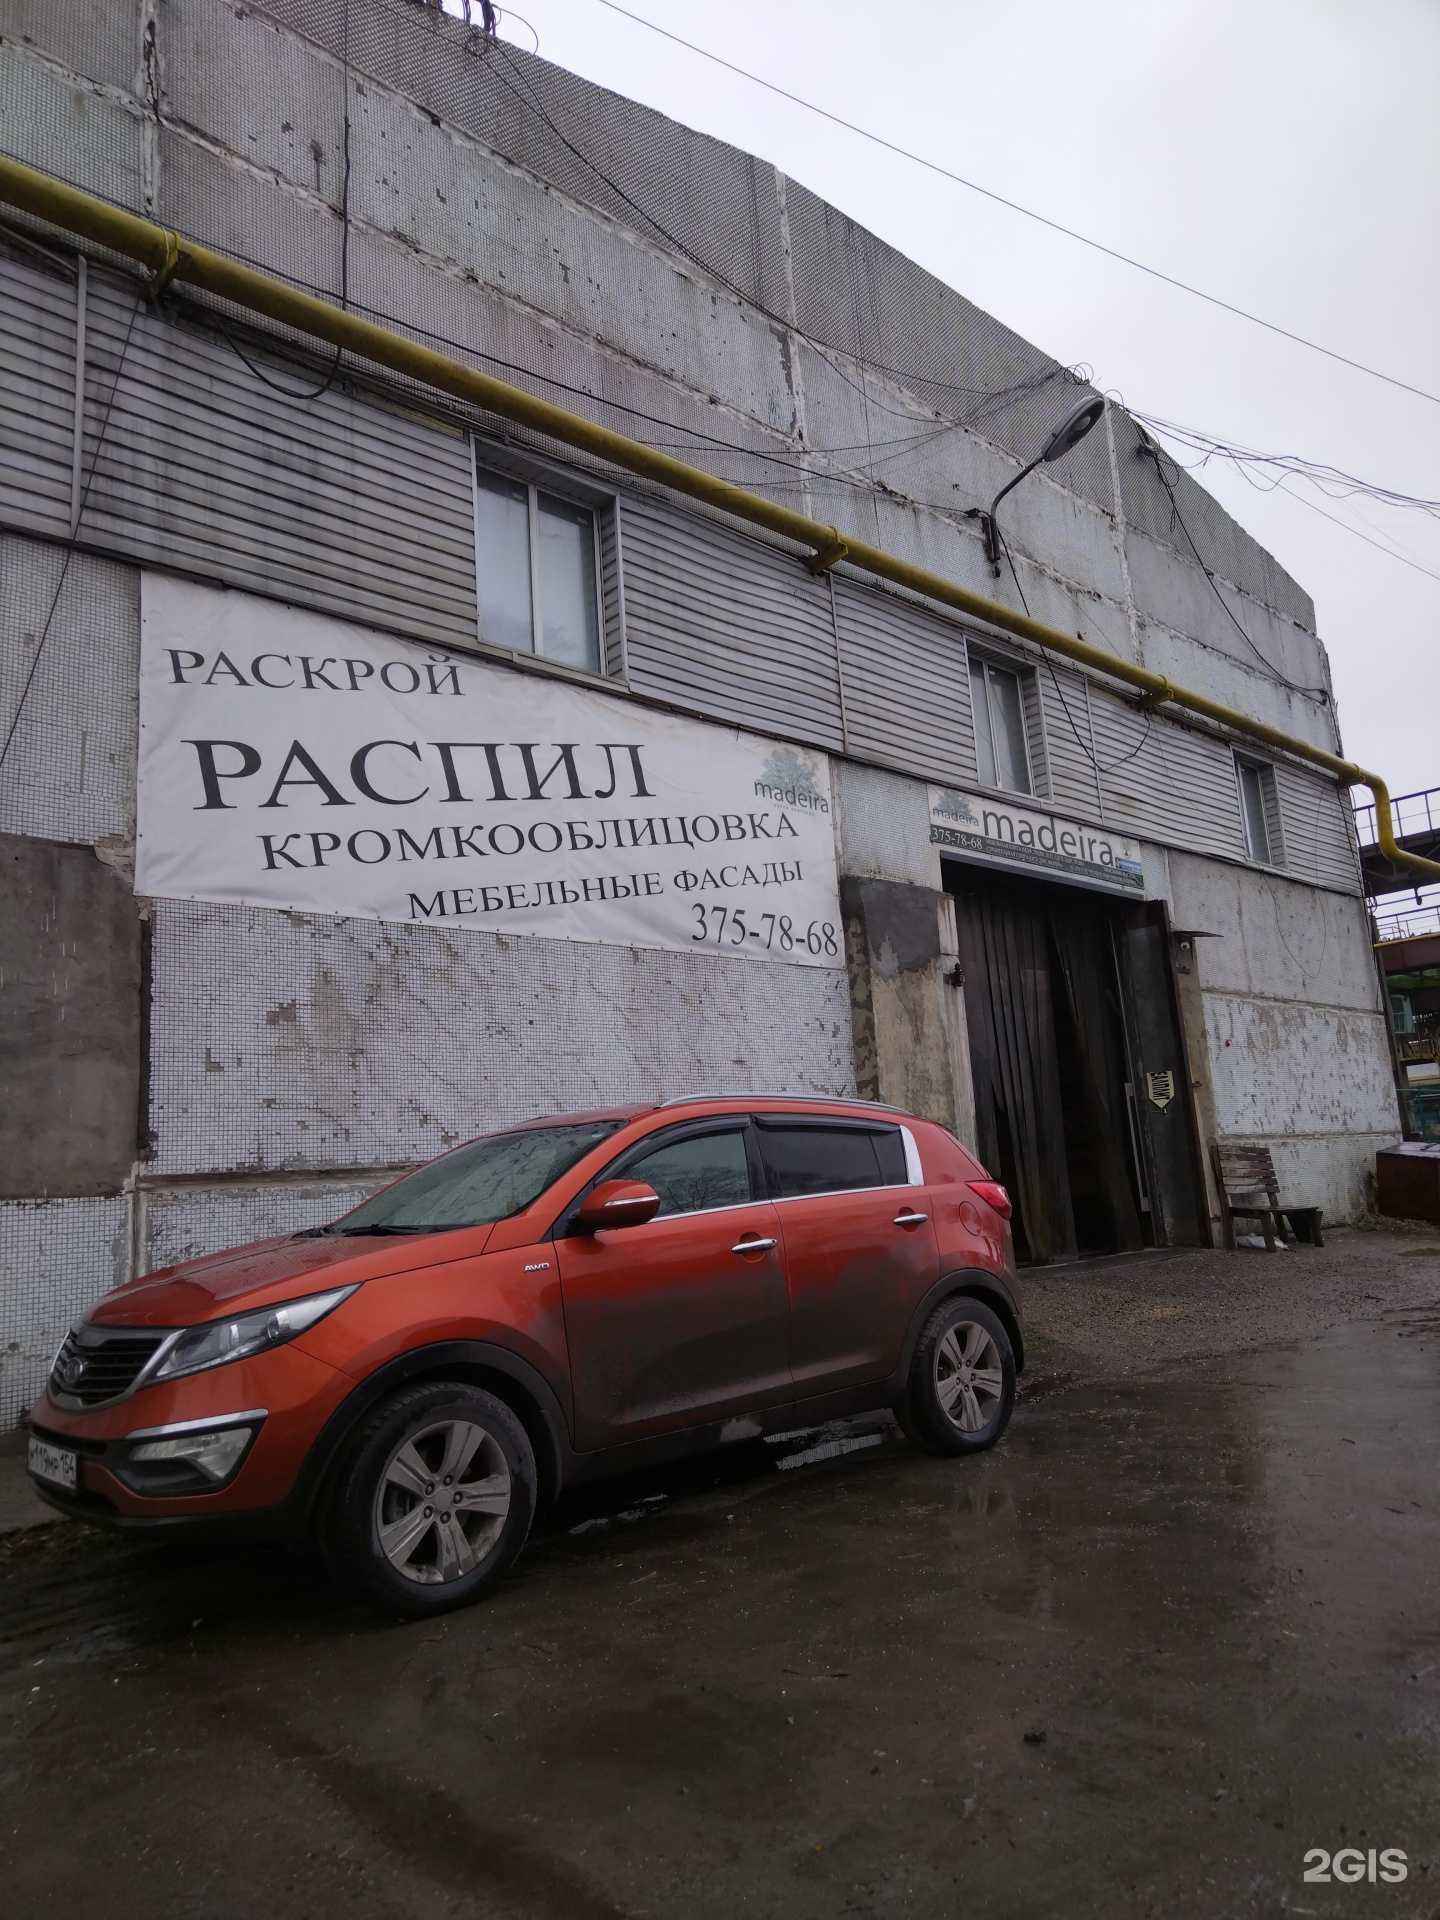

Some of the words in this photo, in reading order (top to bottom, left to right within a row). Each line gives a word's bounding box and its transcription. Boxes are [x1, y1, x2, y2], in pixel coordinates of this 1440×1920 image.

[163, 648, 466, 696] РАСКРОЙ
[180, 739, 656, 810] РАСПИЛ
[754, 781, 829, 813] madeira
[256, 811, 800, 871] КРОМКООБЛИЦОВКА
[932, 828, 983, 850] 375-78-68
[983, 809, 1114, 866] madeira
[405, 871, 665, 919] МЕБЕЛЬНЫЕ
[673, 860, 804, 893] ФАСАДЫ
[691, 902, 838, 957] 375-78-68
[524, 1261, 550, 1272] AWD
